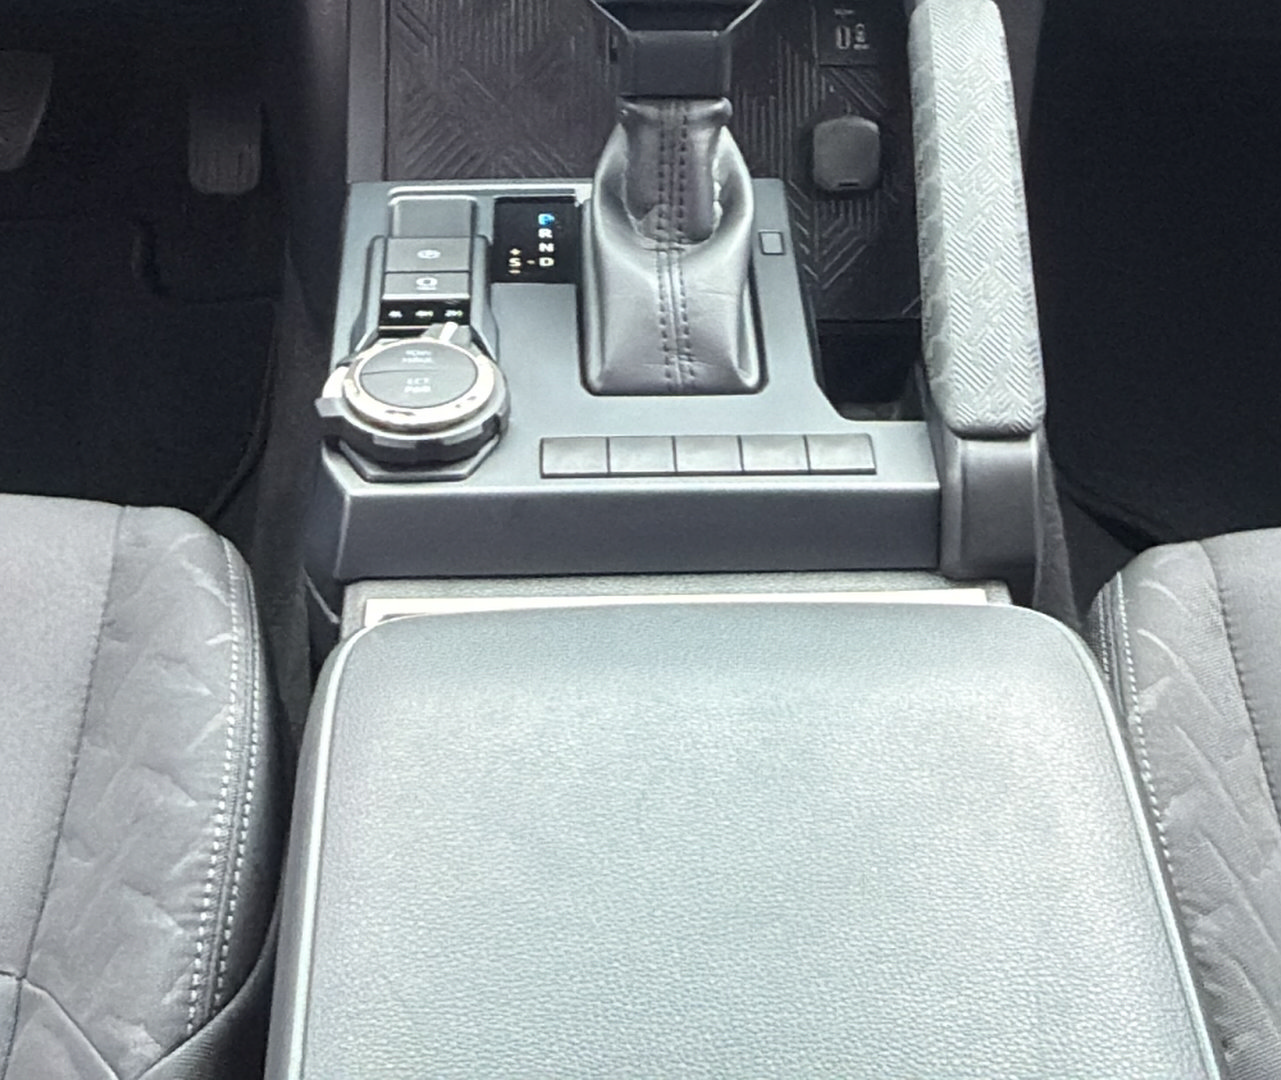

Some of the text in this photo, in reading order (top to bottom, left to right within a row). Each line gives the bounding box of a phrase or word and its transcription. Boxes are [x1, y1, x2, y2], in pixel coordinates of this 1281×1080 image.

[538, 228, 553, 239] R
[538, 242, 555, 253] N
[508, 257, 555, 267] S D
